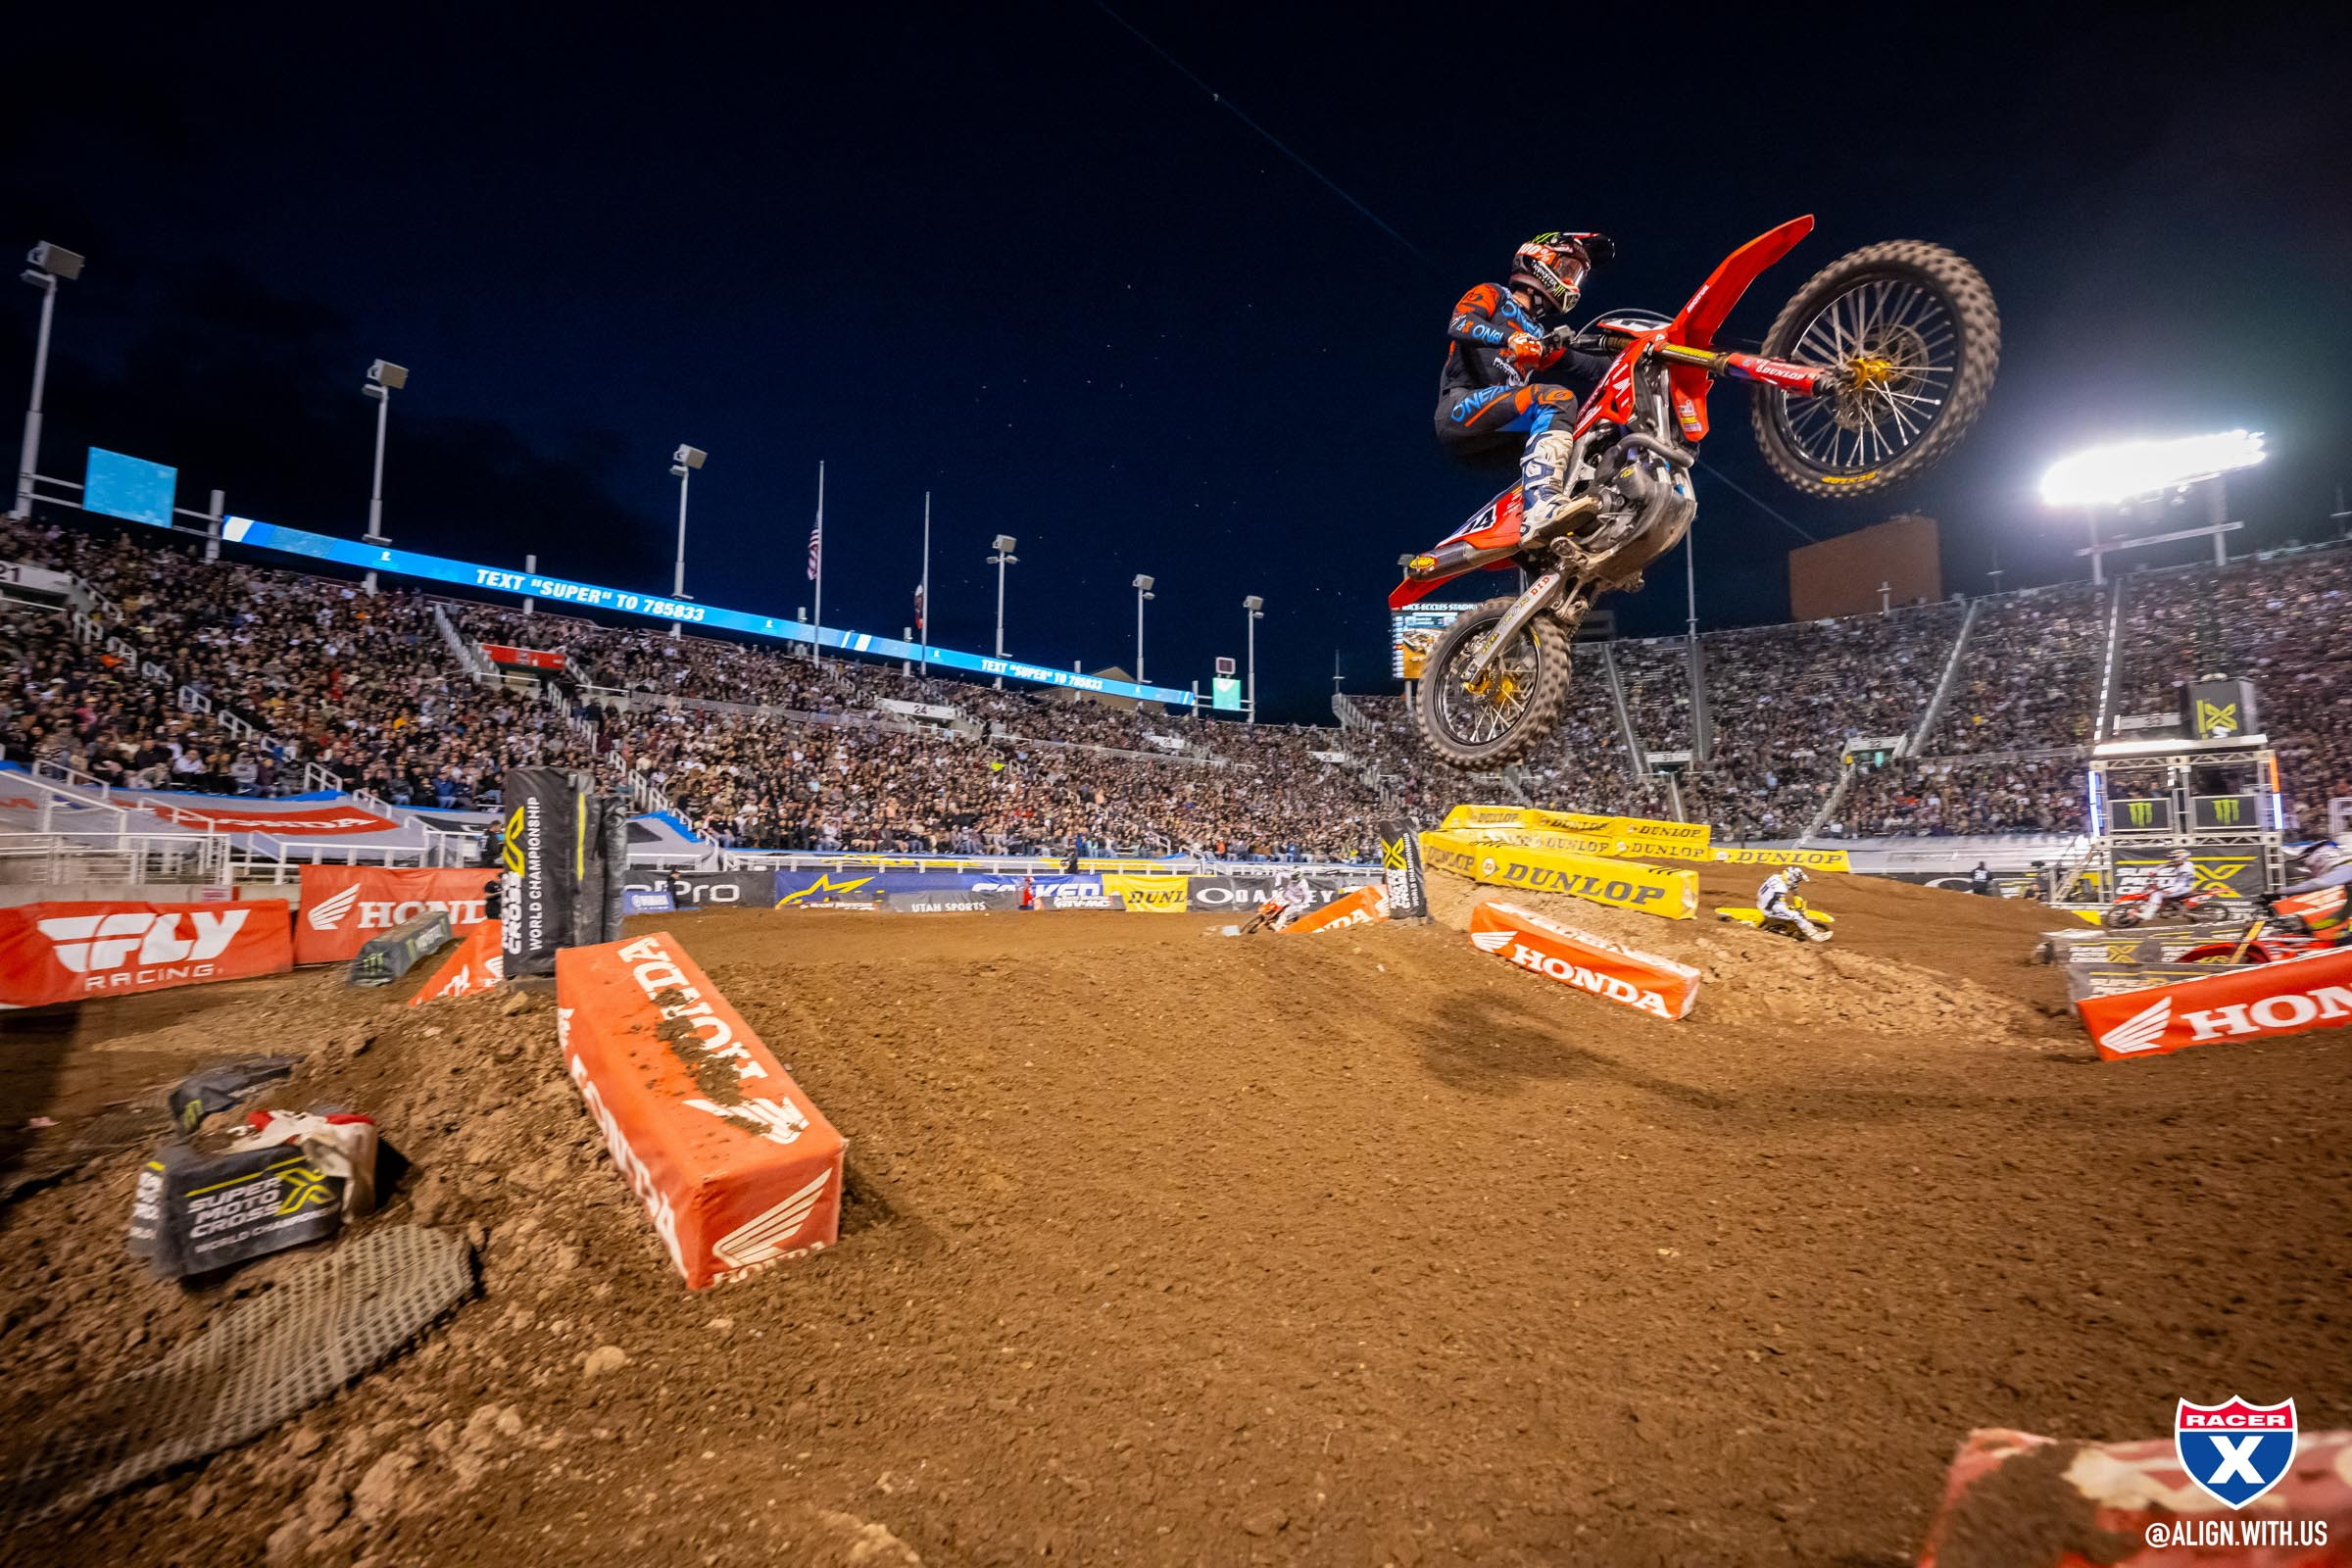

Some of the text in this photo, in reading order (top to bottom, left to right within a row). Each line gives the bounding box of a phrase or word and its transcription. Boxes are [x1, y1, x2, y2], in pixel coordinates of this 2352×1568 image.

[476, 568, 706, 622] TEXT "SUPER" TO 785833
[981, 659, 1007, 672] TEXT
[1009, 663, 1053, 680] "SUPER"
[1054, 673, 1067, 684] TO
[913, 705, 927, 714] 24
[1545, 838, 1610, 854] DUNLOP
[1639, 825, 1702, 839] DUNLOP
[1631, 842, 1705, 858] DUNLOP
[1736, 850, 1843, 865] DUNLOP
[526, 796, 543, 952] WORLD CHAMPIONSHIP
[1502, 862, 1666, 906] DUNLOP
[357, 901, 488, 929] HOND
[508, 870, 522, 956] CROSS
[911, 902, 986, 912] UTAH SPORTS
[37, 908, 251, 973] FLY
[84, 963, 218, 992] RACING
[1510, 943, 1674, 1018] HONDA
[187, 1176, 283, 1214] SUPER
[195, 1189, 281, 1226] MOTO
[189, 1200, 283, 1239] CROSS
[195, 1231, 250, 1254] WORLD
